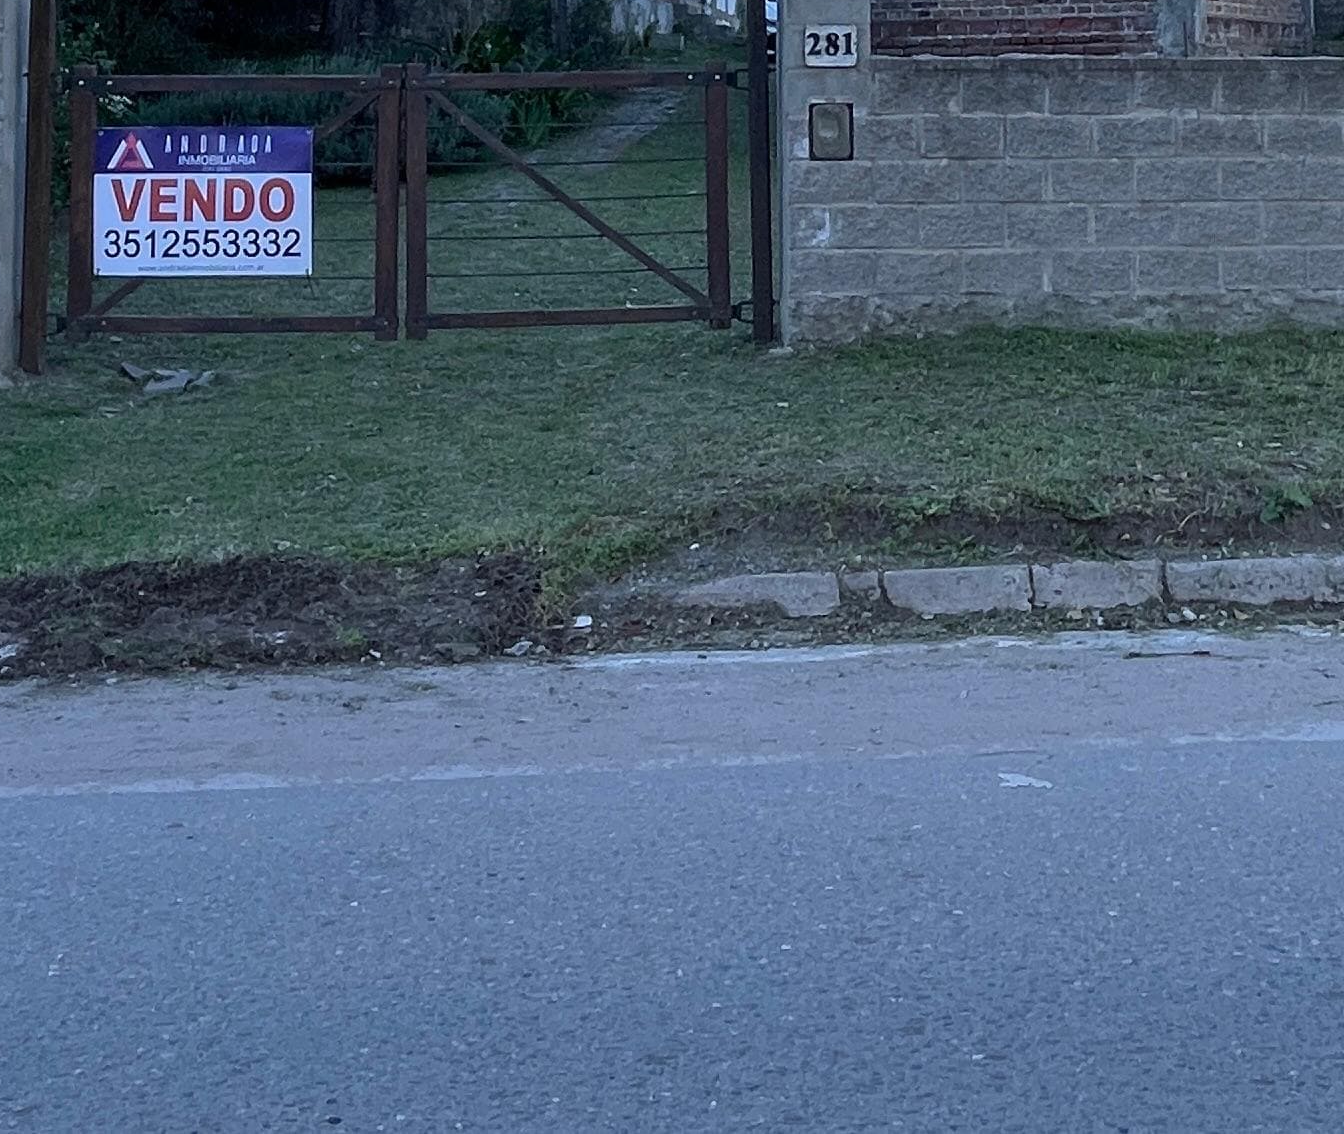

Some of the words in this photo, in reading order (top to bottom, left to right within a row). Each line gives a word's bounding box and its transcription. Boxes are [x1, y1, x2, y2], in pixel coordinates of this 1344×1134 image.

[806, 32, 854, 56] 281
[177, 154, 257, 166] INMOBILIARIA
[111, 178, 295, 222] VENDO
[104, 229, 302, 258] 3512553332
